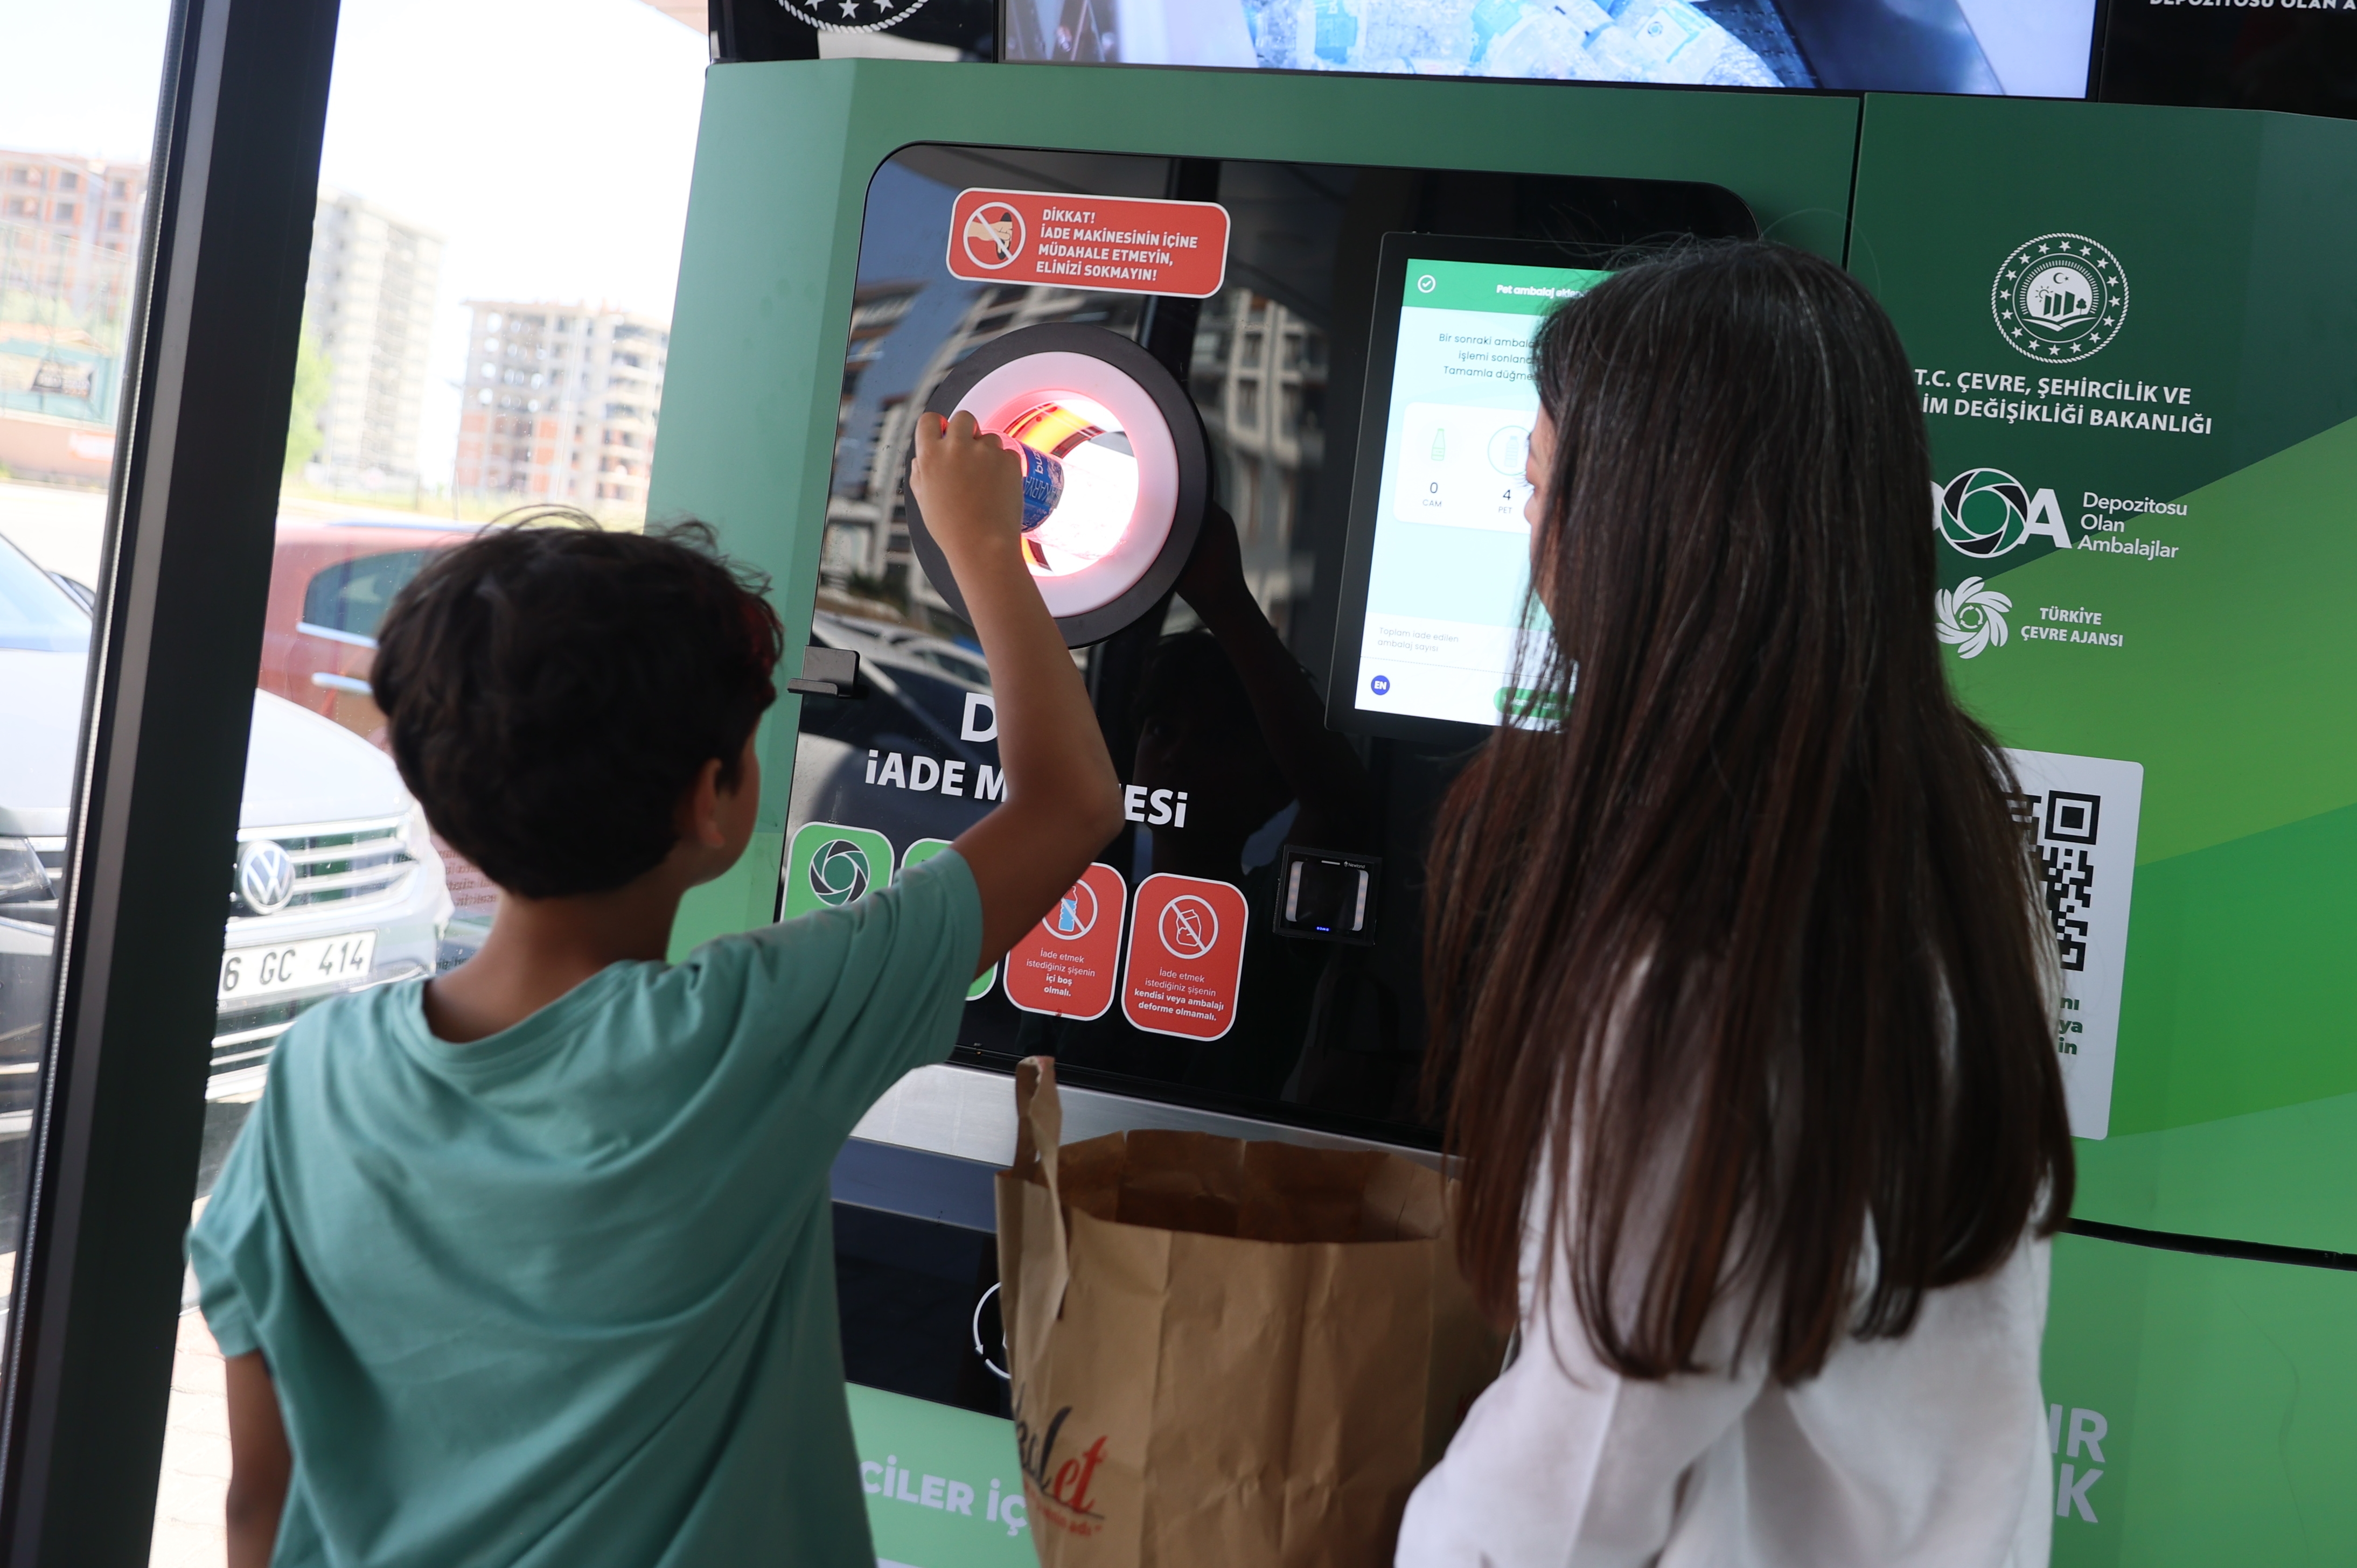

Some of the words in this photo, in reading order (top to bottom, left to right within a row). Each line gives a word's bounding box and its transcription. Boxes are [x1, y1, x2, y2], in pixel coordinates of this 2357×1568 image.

[1042, 207, 1096, 224] DİKKAT!
[1041, 225, 1070, 241] İADE
[1073, 228, 1160, 246] MAKİNESİNİN
[1162, 232, 1198, 249] İÇİNE
[1038, 242, 1110, 261] MÜDAHALE
[1112, 248, 1174, 267] ETMEYİN,
[1036, 260, 1082, 276] ELİNİZİ
[1084, 264, 1157, 282] SOKMAYIN!
[1496, 284, 1512, 294] Pet
[1514, 286, 1554, 299] ambalaj
[1439, 333, 1451, 342] Bir
[1454, 334, 1491, 346] sonraki
[1494, 338, 1536, 348] ambala
[1459, 351, 1488, 362] işlemi
[1444, 366, 1493, 378] Tamamla
[1915, 368, 1950, 387] T.C.
[1957, 372, 2031, 396] ÇEVRE,
[2038, 376, 2157, 403] ŞEHİRCİLİK
[2163, 386, 2191, 405] VE
[1920, 393, 1948, 414] İM
[1954, 397, 2084, 425] DEĞİŞİKLİĞİ
[2089, 408, 2212, 435] BAKANLIĞI
[1430, 482, 1438, 493] 0
[1503, 489, 1511, 500] 4
[1423, 499, 1441, 507] CAM
[2083, 492, 2187, 516] Depozitosu
[2080, 514, 2125, 532] Olan
[2077, 535, 2179, 561] Ambalajlar
[2040, 606, 2102, 625] TÜRKİYE
[1379, 628, 1410, 640] Toplam
[1413, 631, 1431, 639] iade
[1433, 633, 1459, 642] edilen
[2020, 626, 2067, 641] ÇEVRE
[2070, 631, 2123, 647] AJANSI
[1378, 639, 1413, 651] ambalaj
[1415, 643, 1438, 654] sayısı
[1374, 681, 1386, 690] EN
[259, 949, 296, 985] GC
[318, 940, 364, 976] 414
[1040, 948, 1058, 959] İade
[1059, 952, 1084, 963] etmek
[1027, 958, 1066, 974] istediğiniz
[1068, 966, 1096, 977] şişenin
[1159, 967, 1177, 978] İade
[1179, 971, 1205, 983] etmek
[1045, 974, 1056, 984] içi
[1057, 976, 1072, 987] boş
[1145, 978, 1186, 993] istediğiniz
[1187, 985, 1216, 997] şişenin
[1043, 985, 1071, 997] olmalı.
[1134, 988, 1164, 1002] kendisi
[1166, 994, 1186, 1005] veya
[1188, 997, 1224, 1011] ambalajı
[1138, 1000, 1174, 1014] deforme
[1175, 1007, 1217, 1021] olmamalı.
[986, 1478, 1028, 1536] İÇ
